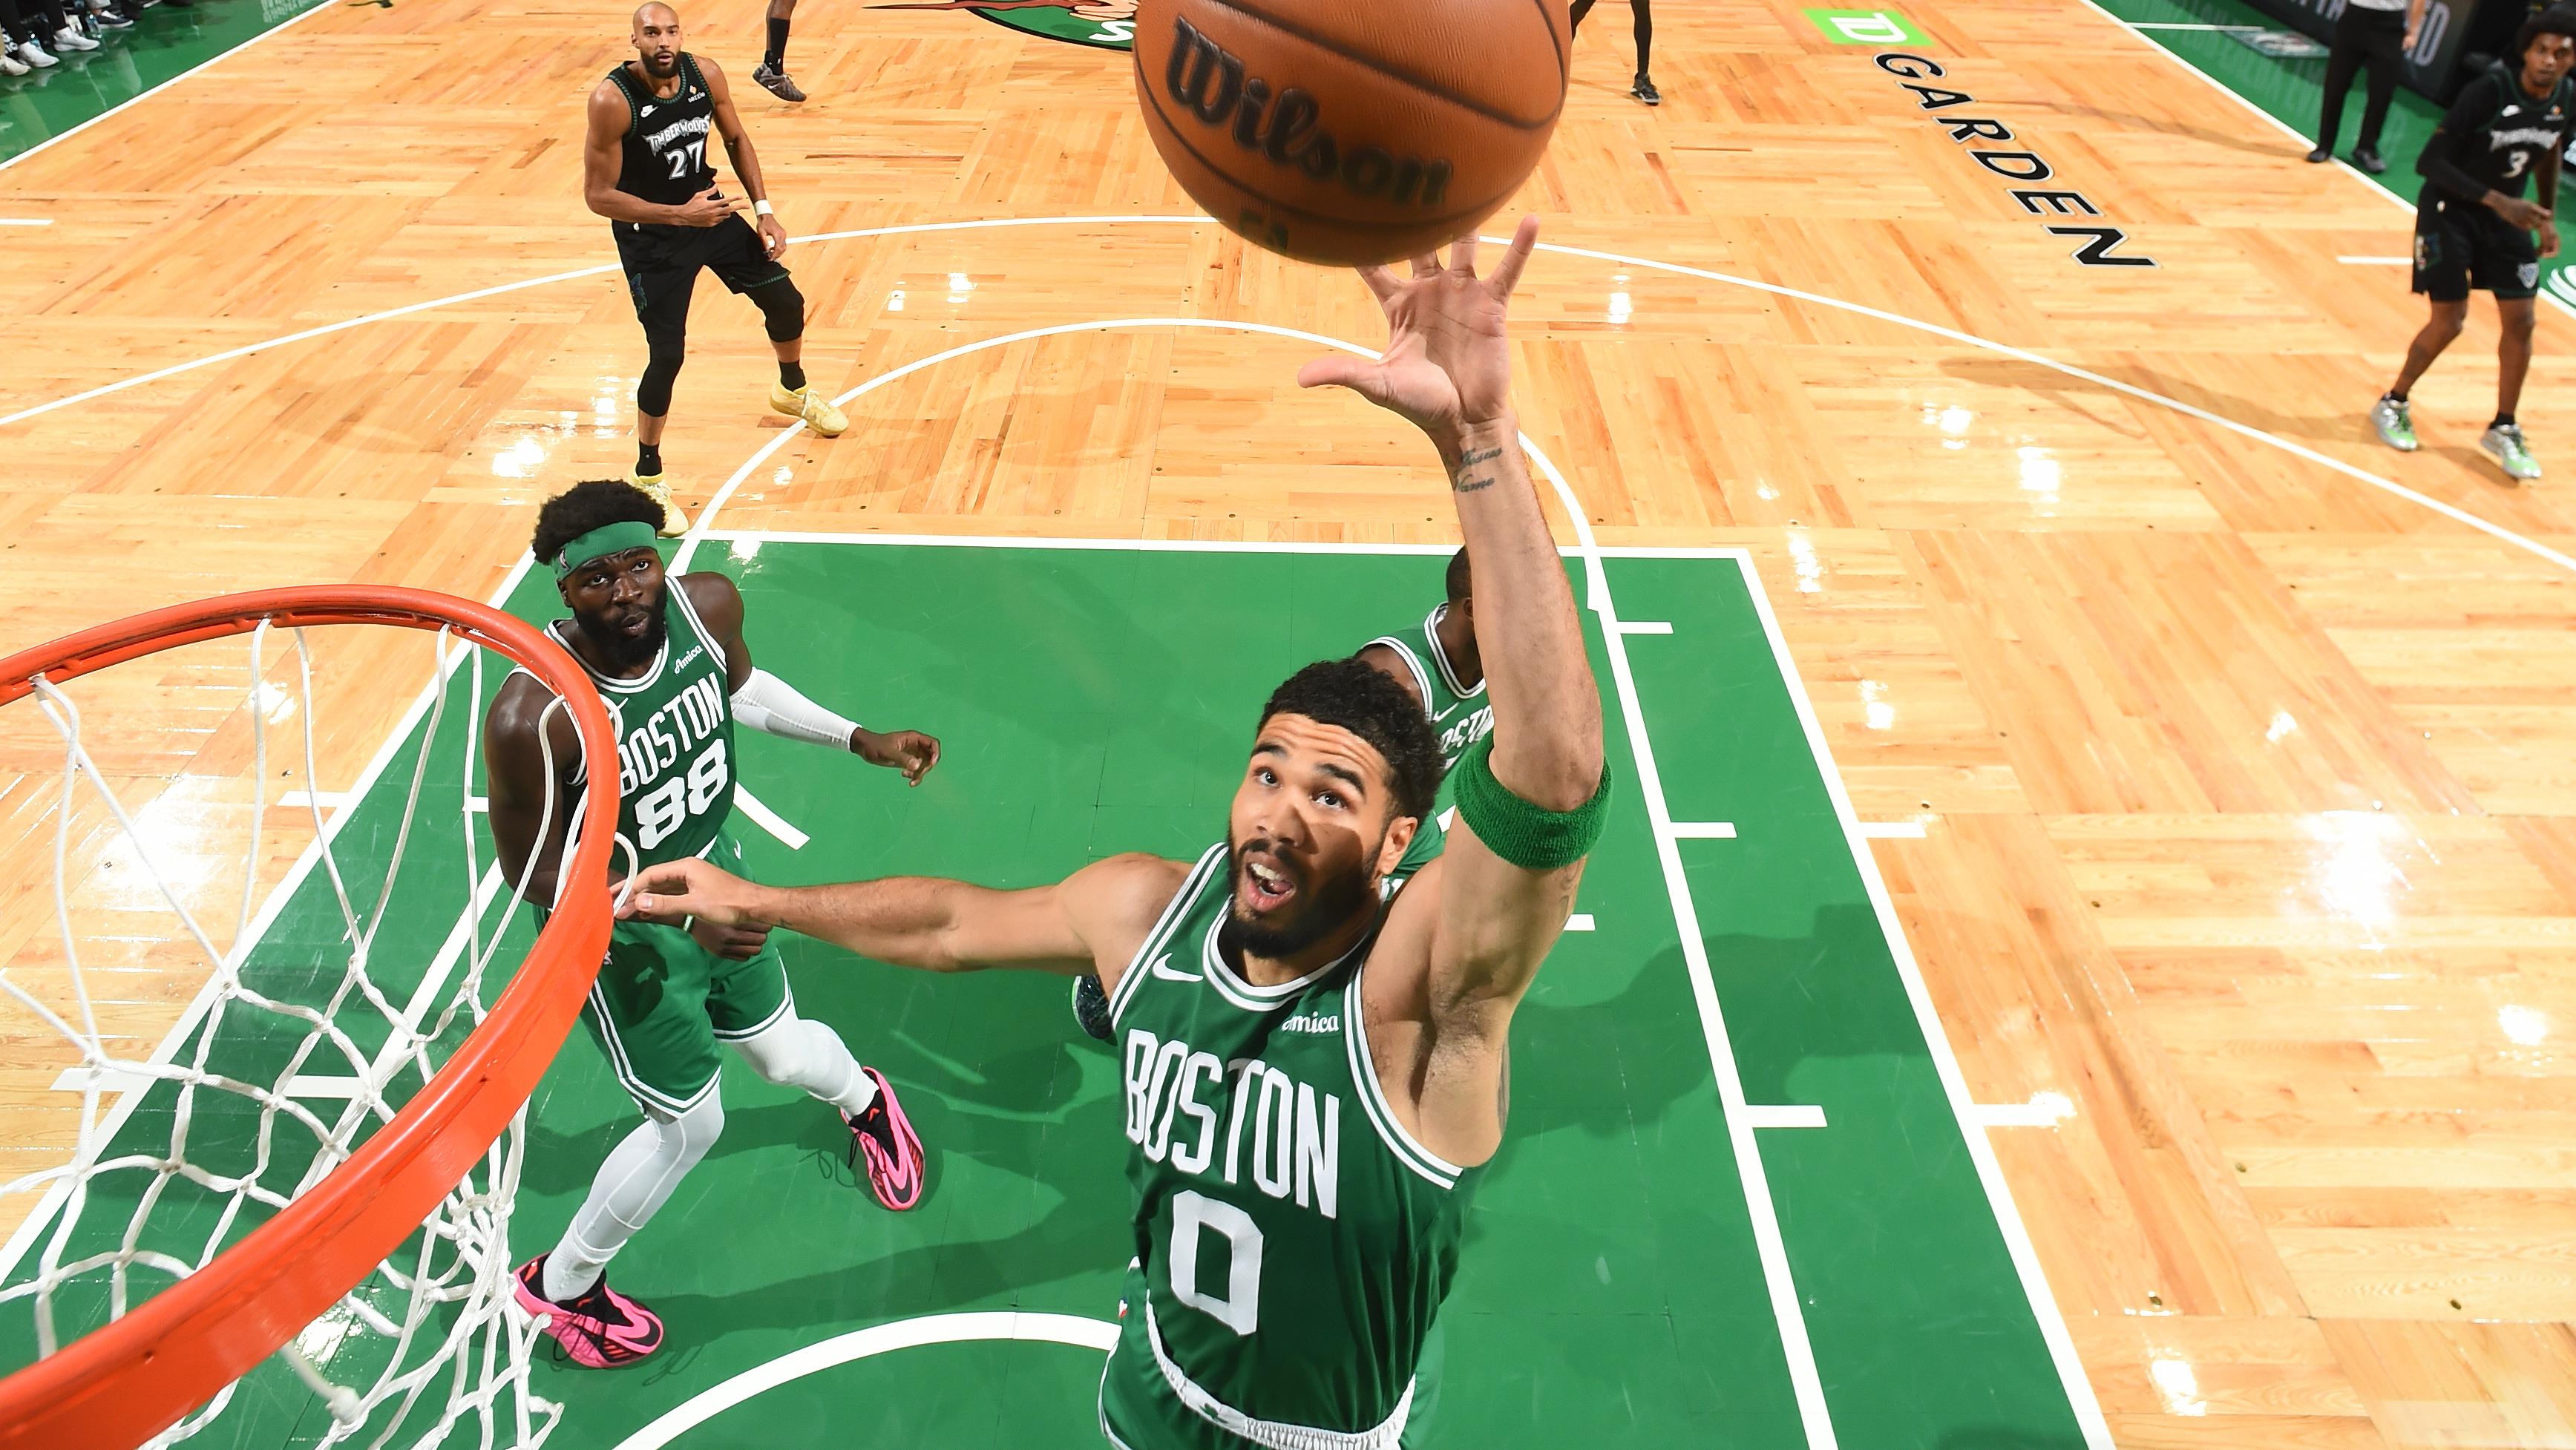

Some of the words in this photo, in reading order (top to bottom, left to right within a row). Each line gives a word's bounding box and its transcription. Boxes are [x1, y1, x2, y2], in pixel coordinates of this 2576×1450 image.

[1829, 12, 1907, 43] TD
[663, 137, 705, 180] 27
[1165, 15, 1453, 206] Wilson
[1872, 51, 2161, 268] GARDEN
[2501, 151, 2530, 178] 3
[674, 644, 704, 675] Amica
[617, 672, 724, 798] BOSTON
[635, 738, 728, 850] 88
[1124, 1028, 1339, 1219] BOSTON
[1170, 1190, 1264, 1336] 0
